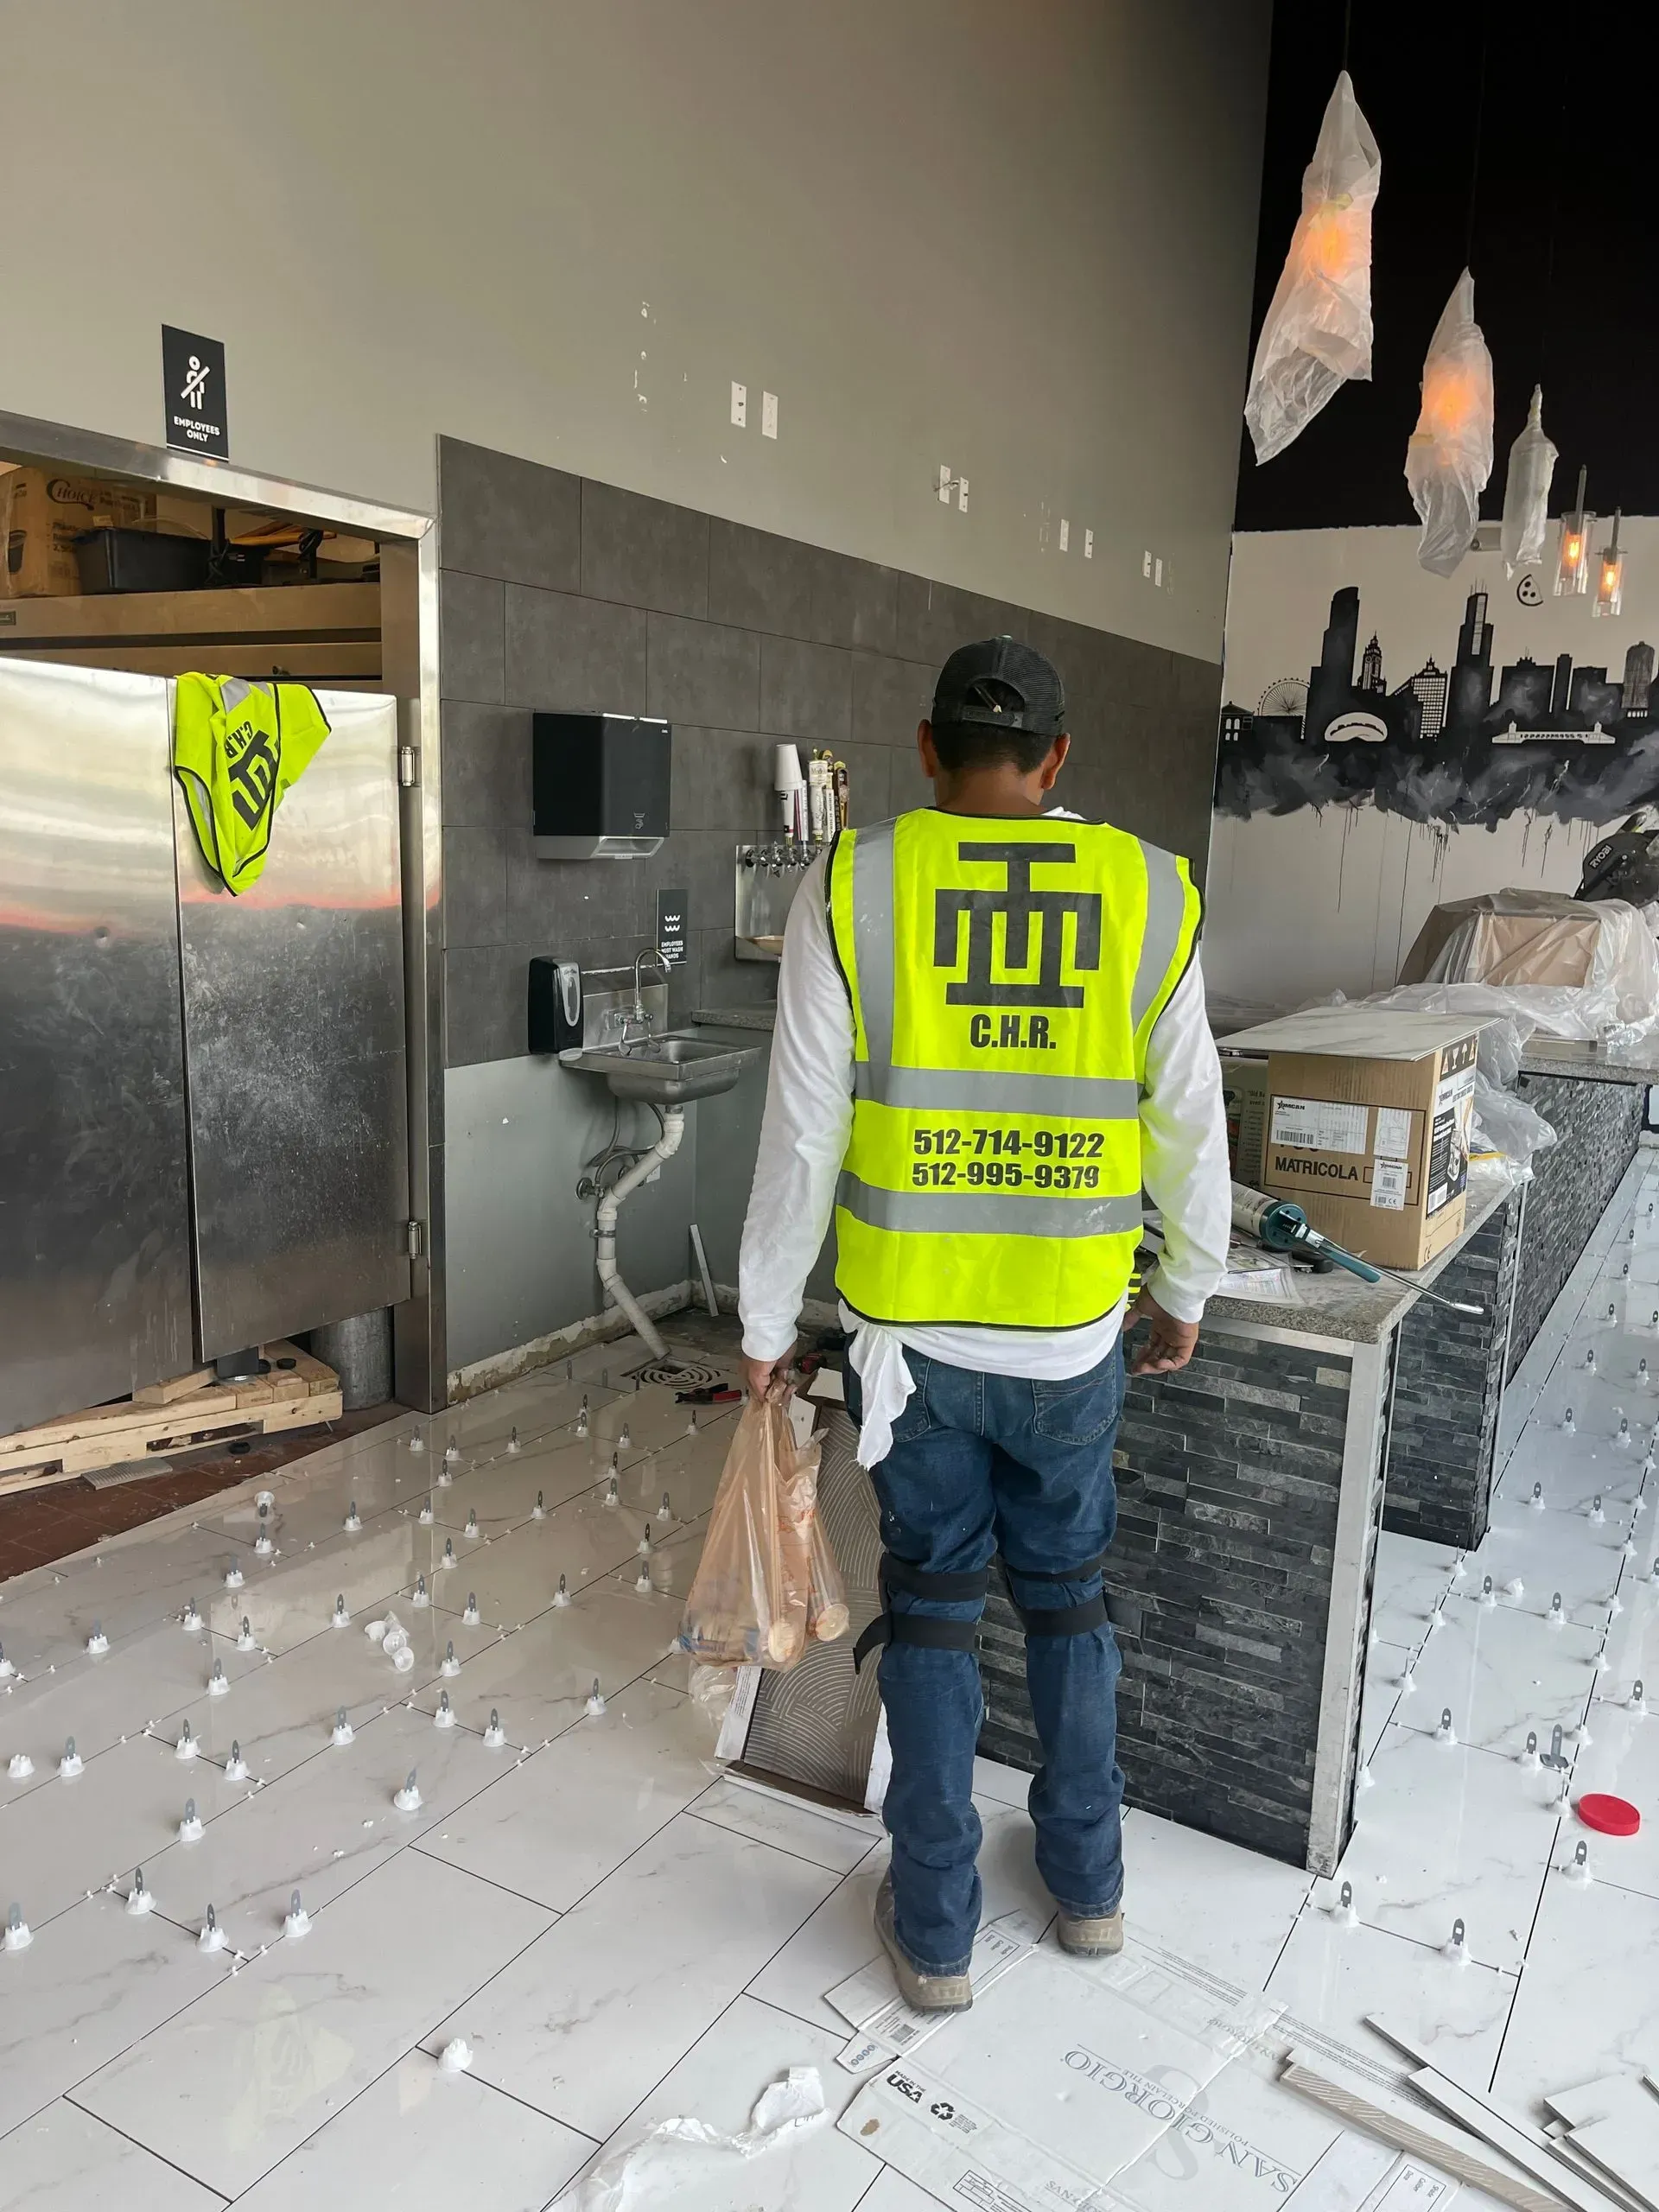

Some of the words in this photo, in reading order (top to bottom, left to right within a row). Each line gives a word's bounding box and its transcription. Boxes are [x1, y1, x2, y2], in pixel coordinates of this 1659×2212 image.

[174, 416, 220, 436] EMPLOYEES
[187, 429, 208, 442] ONLY
[1589, 844, 1612, 868] RYOBI
[970, 1014, 1056, 1049] C.H.R.
[913, 1128, 1105, 1158] 512-714-9122
[912, 1161, 1100, 1189] 512-995-9379
[1275, 1156, 1358, 1181] MATRICOLA
[887, 2074, 923, 2104] USA
[894, 2070, 910, 2082] MADE
[1064, 2050, 1214, 2144] GIORGIO
[1200, 2116, 1249, 2146] POLISHED
[1217, 2140, 1298, 2193] SAN
